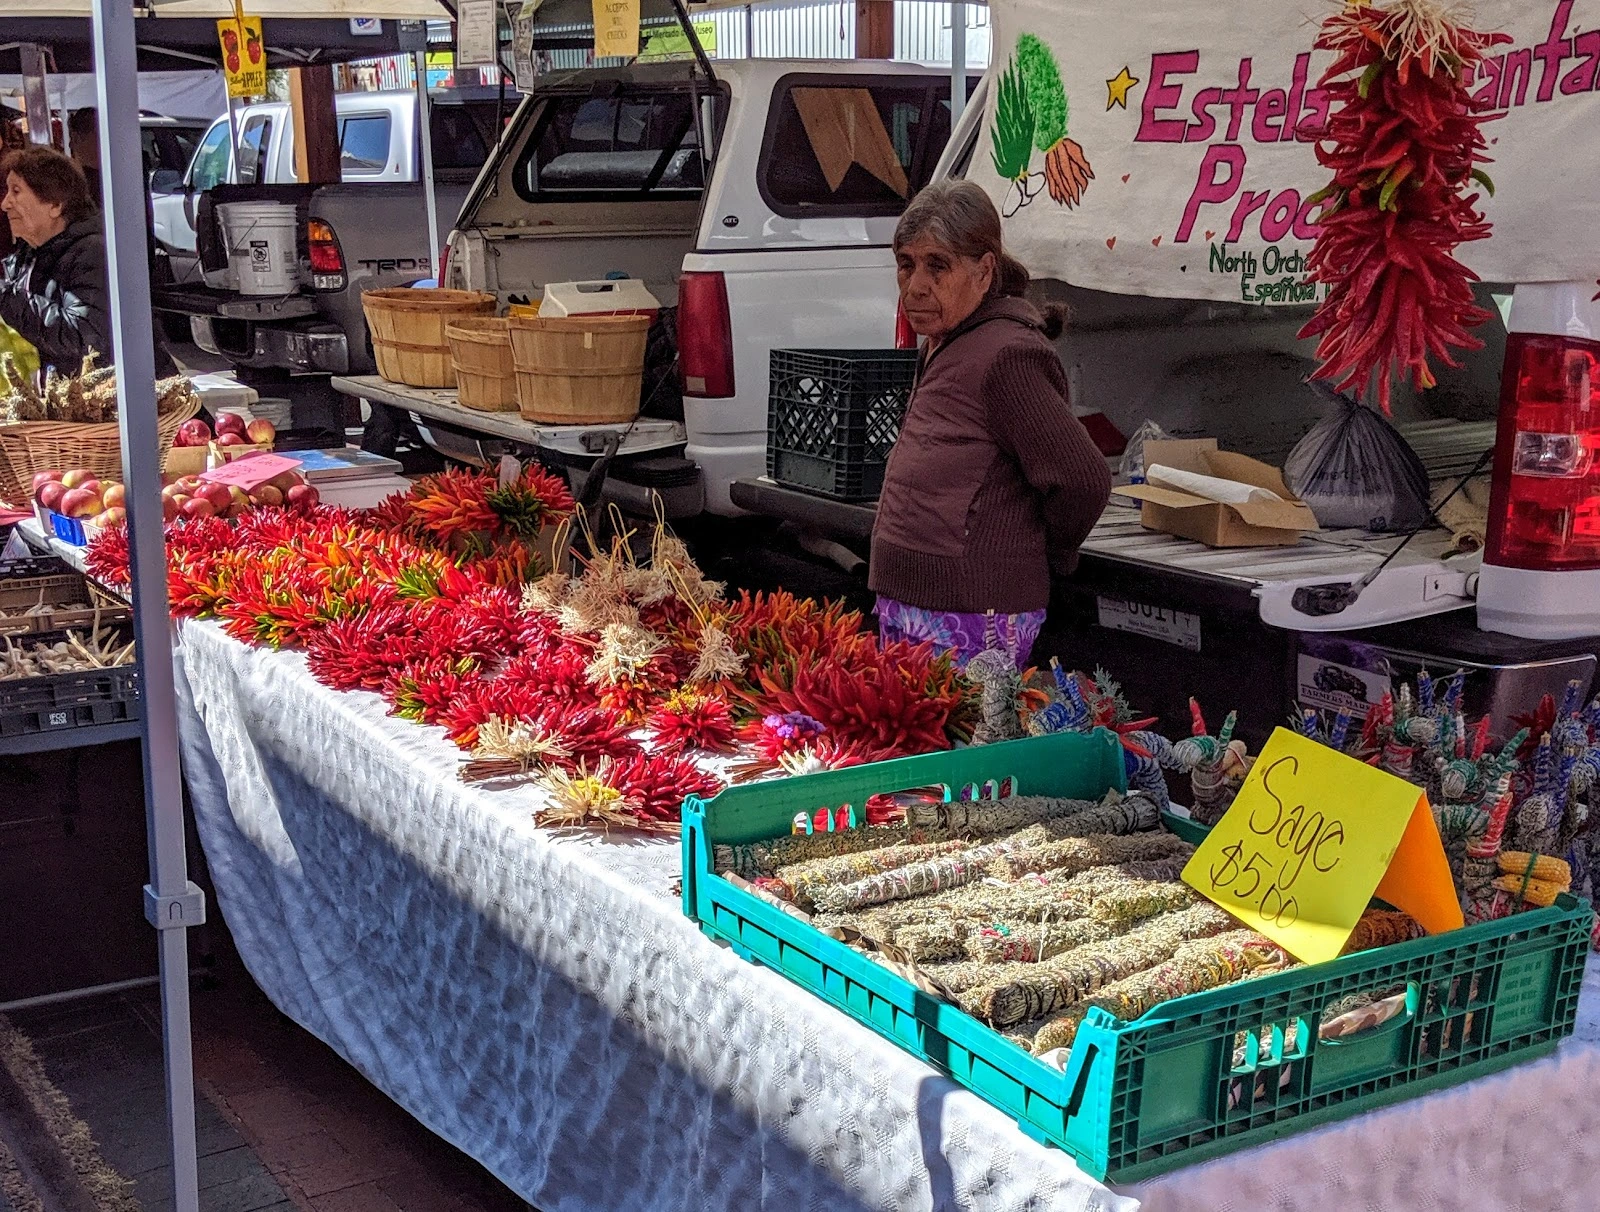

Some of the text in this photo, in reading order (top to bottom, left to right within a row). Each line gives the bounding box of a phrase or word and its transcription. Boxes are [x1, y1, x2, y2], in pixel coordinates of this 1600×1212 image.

[1134, 0, 1600, 143] Estela anta
[358, 258, 416, 275] TRD
[1209, 242, 1317, 276] North Orcha
[1249, 755, 1345, 891] Sage
[1210, 839, 1299, 929] $5.00
